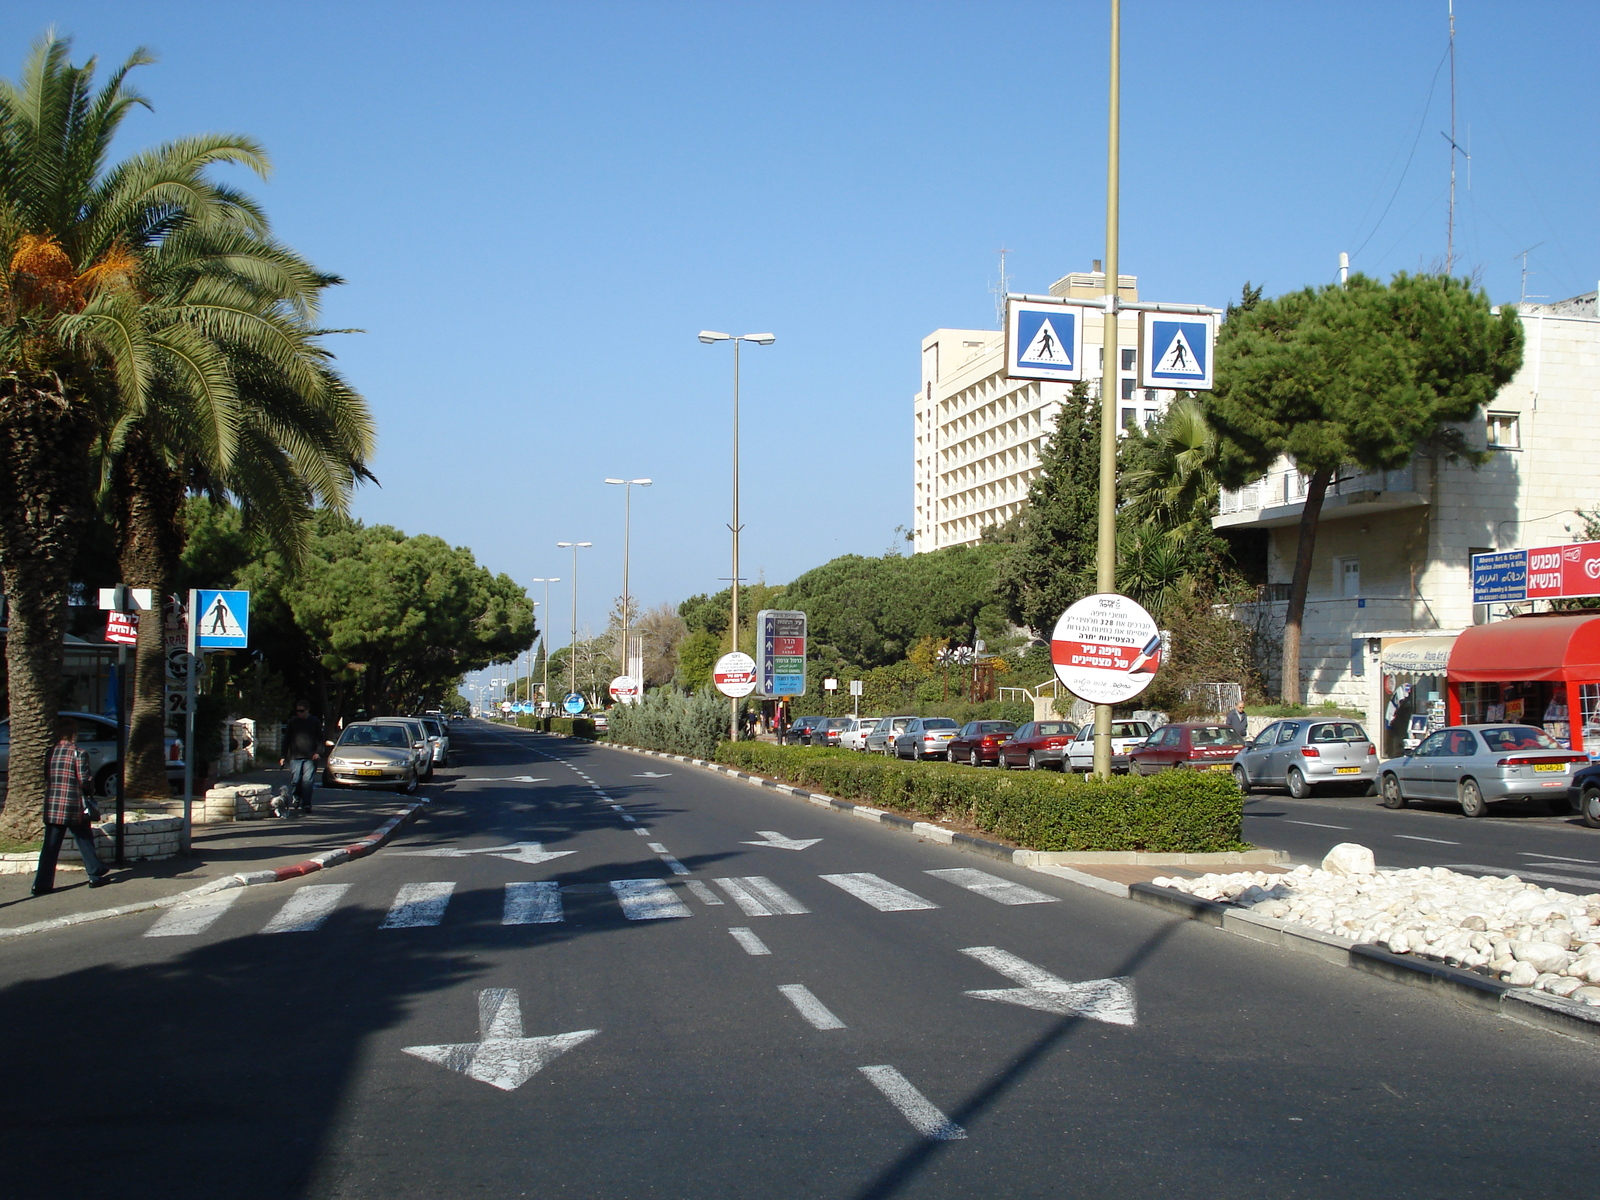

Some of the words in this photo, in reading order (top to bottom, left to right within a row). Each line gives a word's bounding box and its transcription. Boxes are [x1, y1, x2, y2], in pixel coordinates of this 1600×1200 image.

[1531, 553, 1560, 571] מפגש
[1529, 573, 1561, 589] הנשיא
[1099, 636, 1135, 644] בהצטיינות
[1081, 644, 1097, 654] עיר
[1099, 646, 1122, 656] חיפה
[1071, 655, 1111, 667] מצטיינים
[1113, 657, 1129, 668] של
